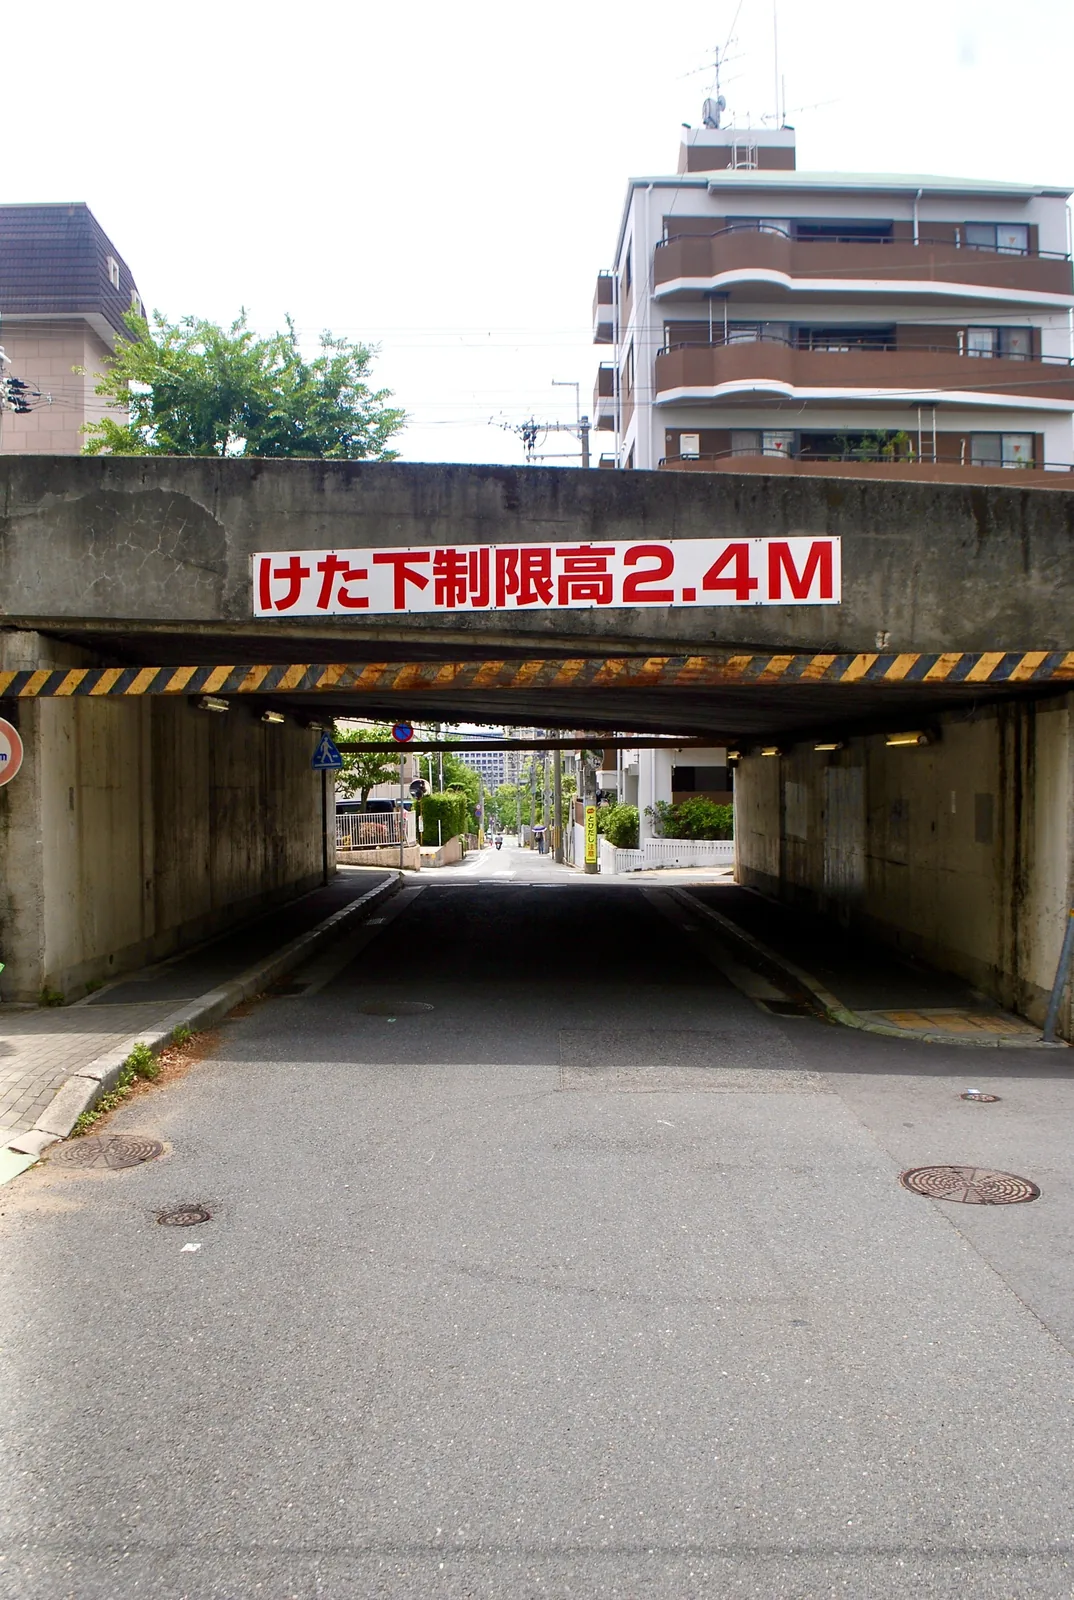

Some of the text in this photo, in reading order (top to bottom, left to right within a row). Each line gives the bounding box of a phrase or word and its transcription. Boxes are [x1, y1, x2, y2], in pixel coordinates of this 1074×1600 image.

[259, 540, 833, 611] けた下制限高2.4M
